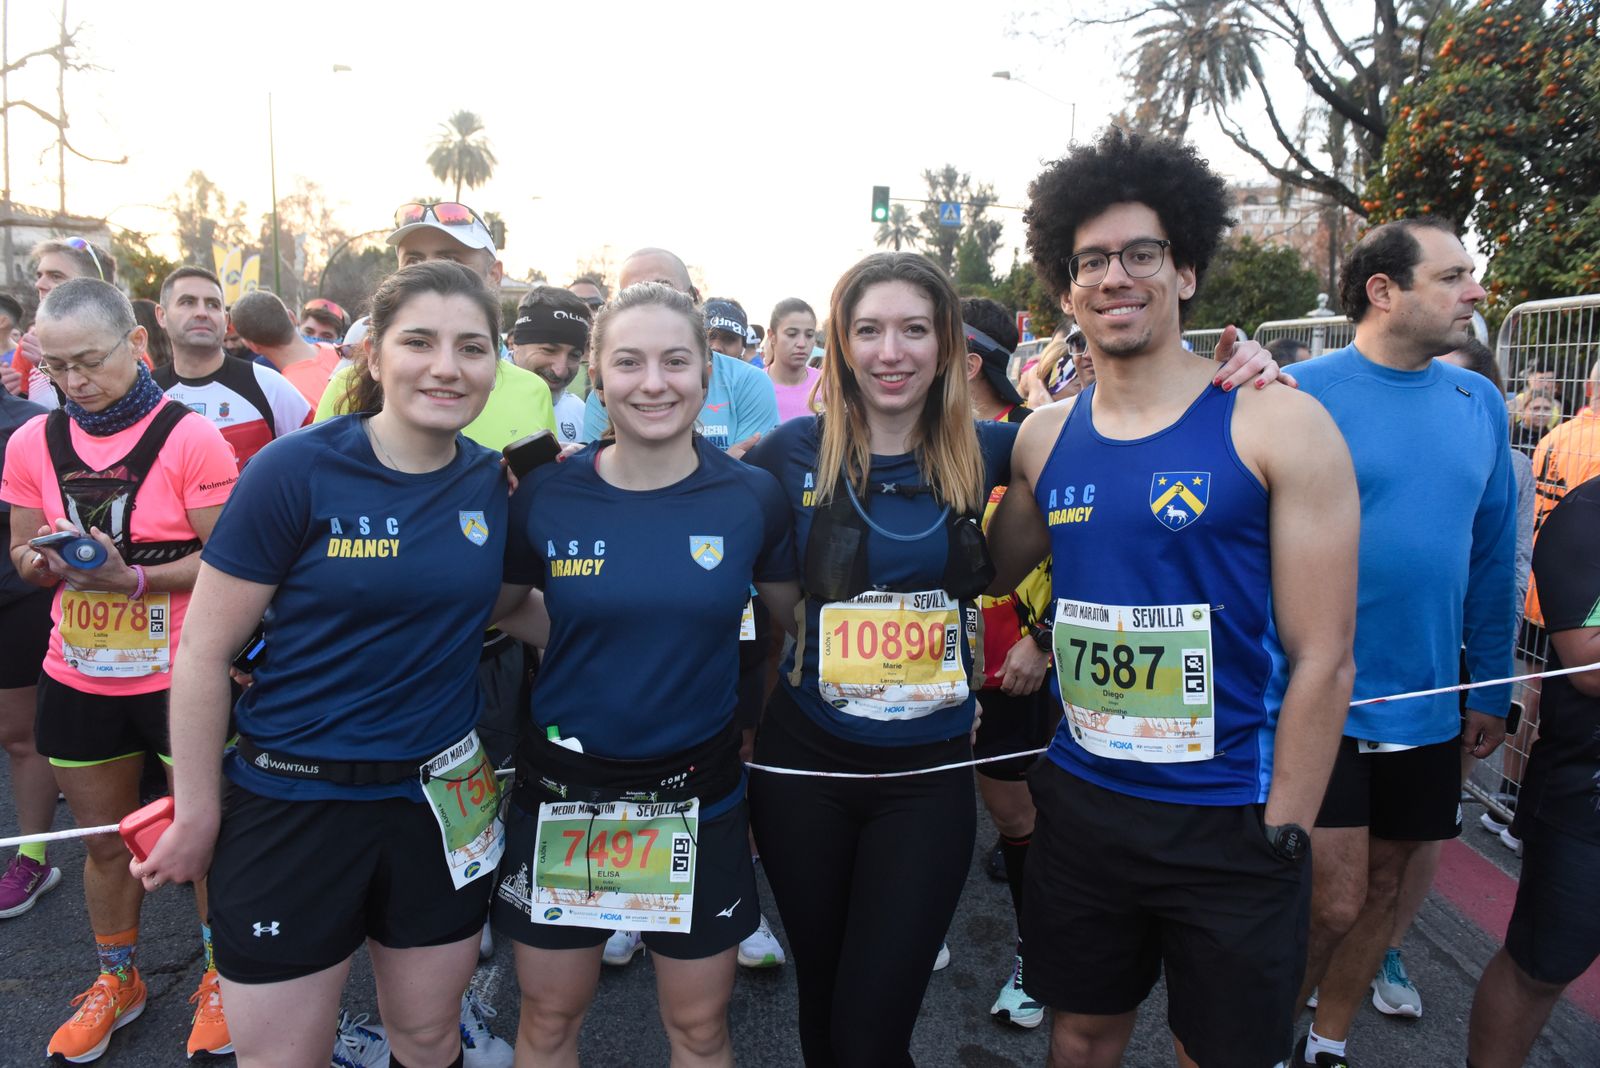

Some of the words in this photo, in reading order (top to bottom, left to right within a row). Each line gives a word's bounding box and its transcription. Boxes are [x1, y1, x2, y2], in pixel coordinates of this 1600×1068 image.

[804, 472, 814, 488] A
[1049, 489, 1057, 509] A
[1063, 485, 1076, 506] S
[1082, 483, 1096, 504] C
[330, 517, 343, 535] A
[358, 516, 371, 536] S
[386, 517, 399, 536] C
[1048, 506, 1094, 527] DRANCY
[327, 537, 400, 558] DRANCY
[547, 539, 556, 558] A
[568, 540, 579, 556] S
[594, 540, 606, 556] C
[551, 558, 605, 577] DRANCY
[68, 598, 148, 632] 10978
[1063, 602, 1079, 618] MEDIO
[1079, 605, 1110, 623] MARATÓN
[1132, 607, 1184, 628] SEVILLA
[834, 620, 945, 661] 10890
[883, 662, 902, 670] Marie
[1070, 638, 1165, 689] 7587
[1102, 689, 1125, 700] Diego
[884, 705, 905, 713] HOKA
[1109, 740, 1133, 750] HOKA
[427, 754, 450, 775] MEDIO
[449, 736, 475, 764] MARATÓN
[269, 759, 320, 774] WANTALIS
[551, 804, 576, 816] MEDIO
[578, 802, 616, 816] MAATÓN
[636, 803, 678, 818] SEVILLA
[562, 829, 660, 869] 7497
[597, 870, 620, 878] ELISA
[600, 912, 622, 921] HOKA
